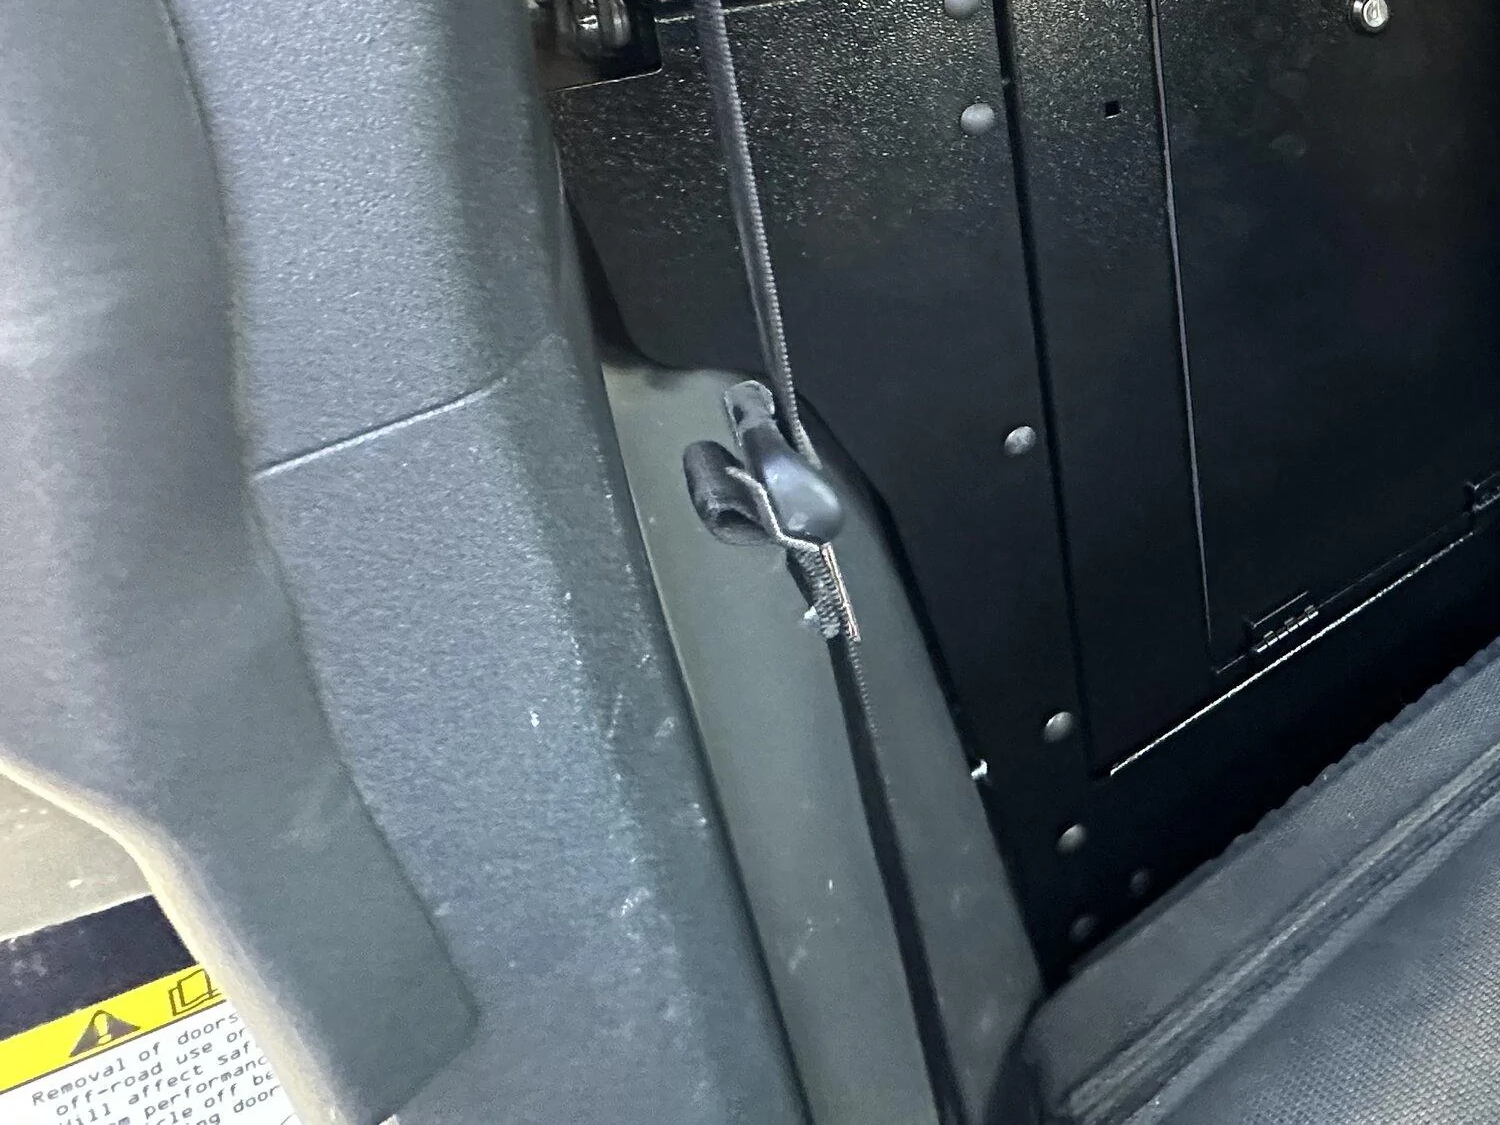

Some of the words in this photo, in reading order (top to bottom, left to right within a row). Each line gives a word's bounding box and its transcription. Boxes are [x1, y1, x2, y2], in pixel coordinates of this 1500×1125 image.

[32, 1057, 126, 1106] Removal
[138, 1041, 160, 1062] of
[177, 1012, 239, 1045] doors
[56, 1061, 163, 1116] off-road
[176, 1042, 213, 1065] use
[128, 1064, 204, 1105] affect
[204, 1082, 237, 1108] off
